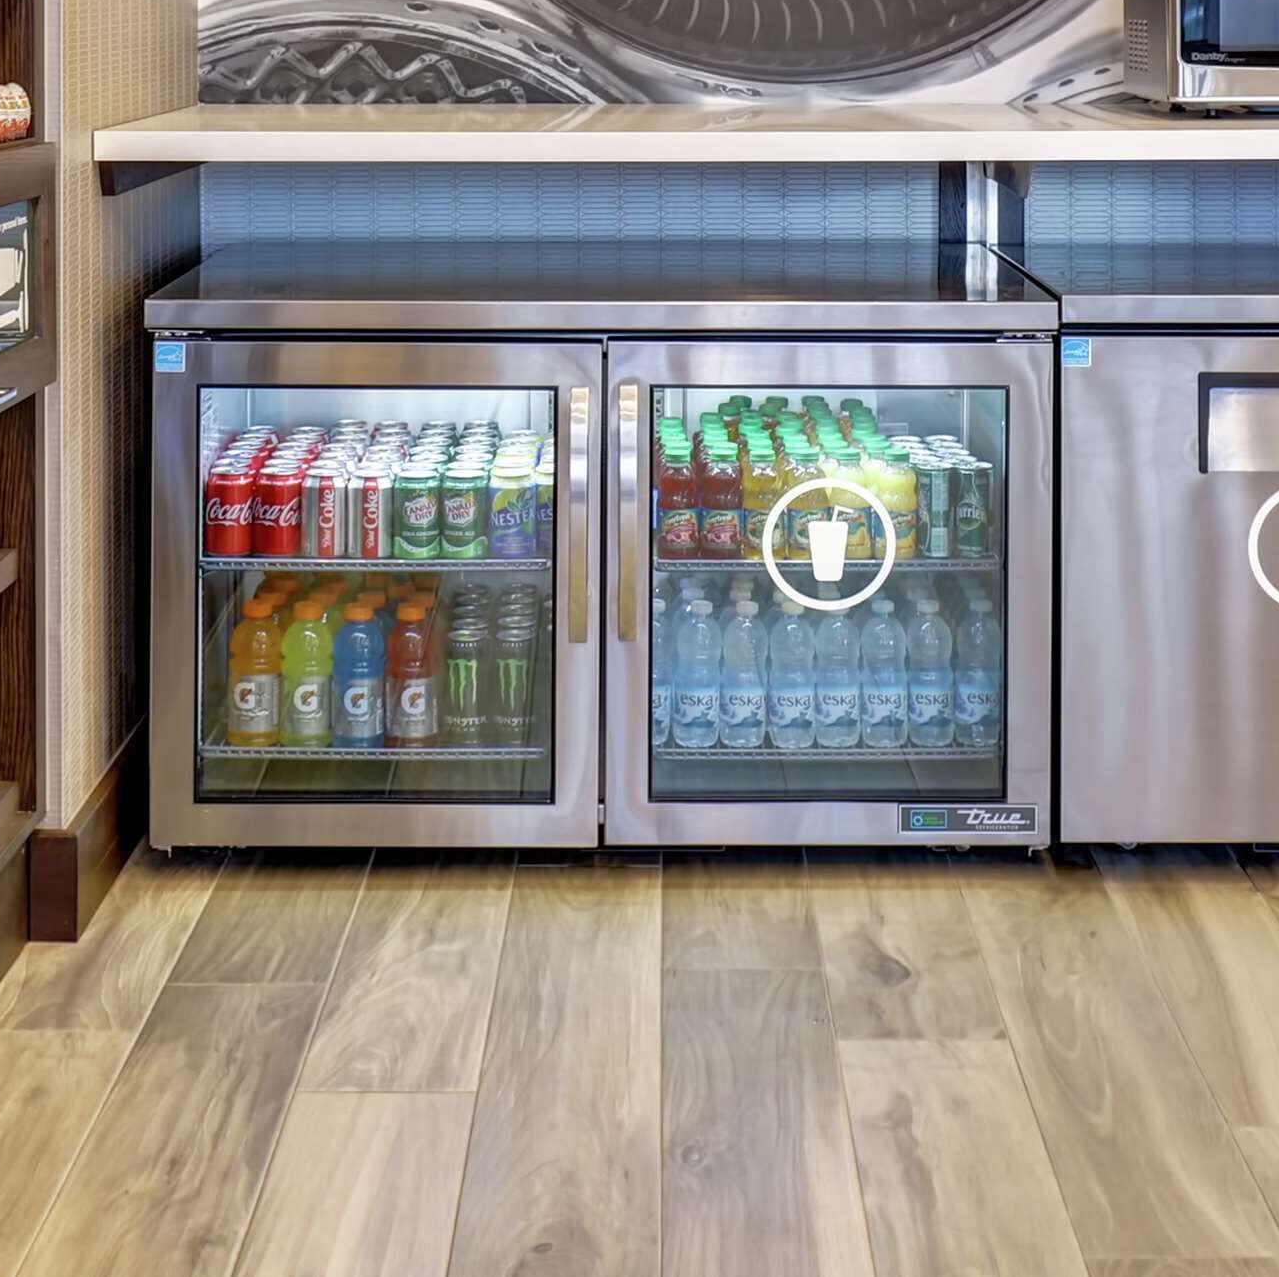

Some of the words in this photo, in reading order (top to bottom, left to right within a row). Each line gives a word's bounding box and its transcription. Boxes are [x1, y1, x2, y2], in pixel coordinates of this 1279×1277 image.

[319, 488, 335, 529] Coke
[363, 489, 378, 530] Coke
[233, 681, 256, 710] G
[293, 683, 319, 713] G
[343, 686, 370, 715] G
[400, 685, 426, 715] G
[679, 692, 714, 711] eska
[728, 692, 763, 711] eska
[777, 693, 811, 711] eska
[822, 691, 857, 709] eska
[867, 691, 902, 708] eska
[915, 691, 949, 709] eska
